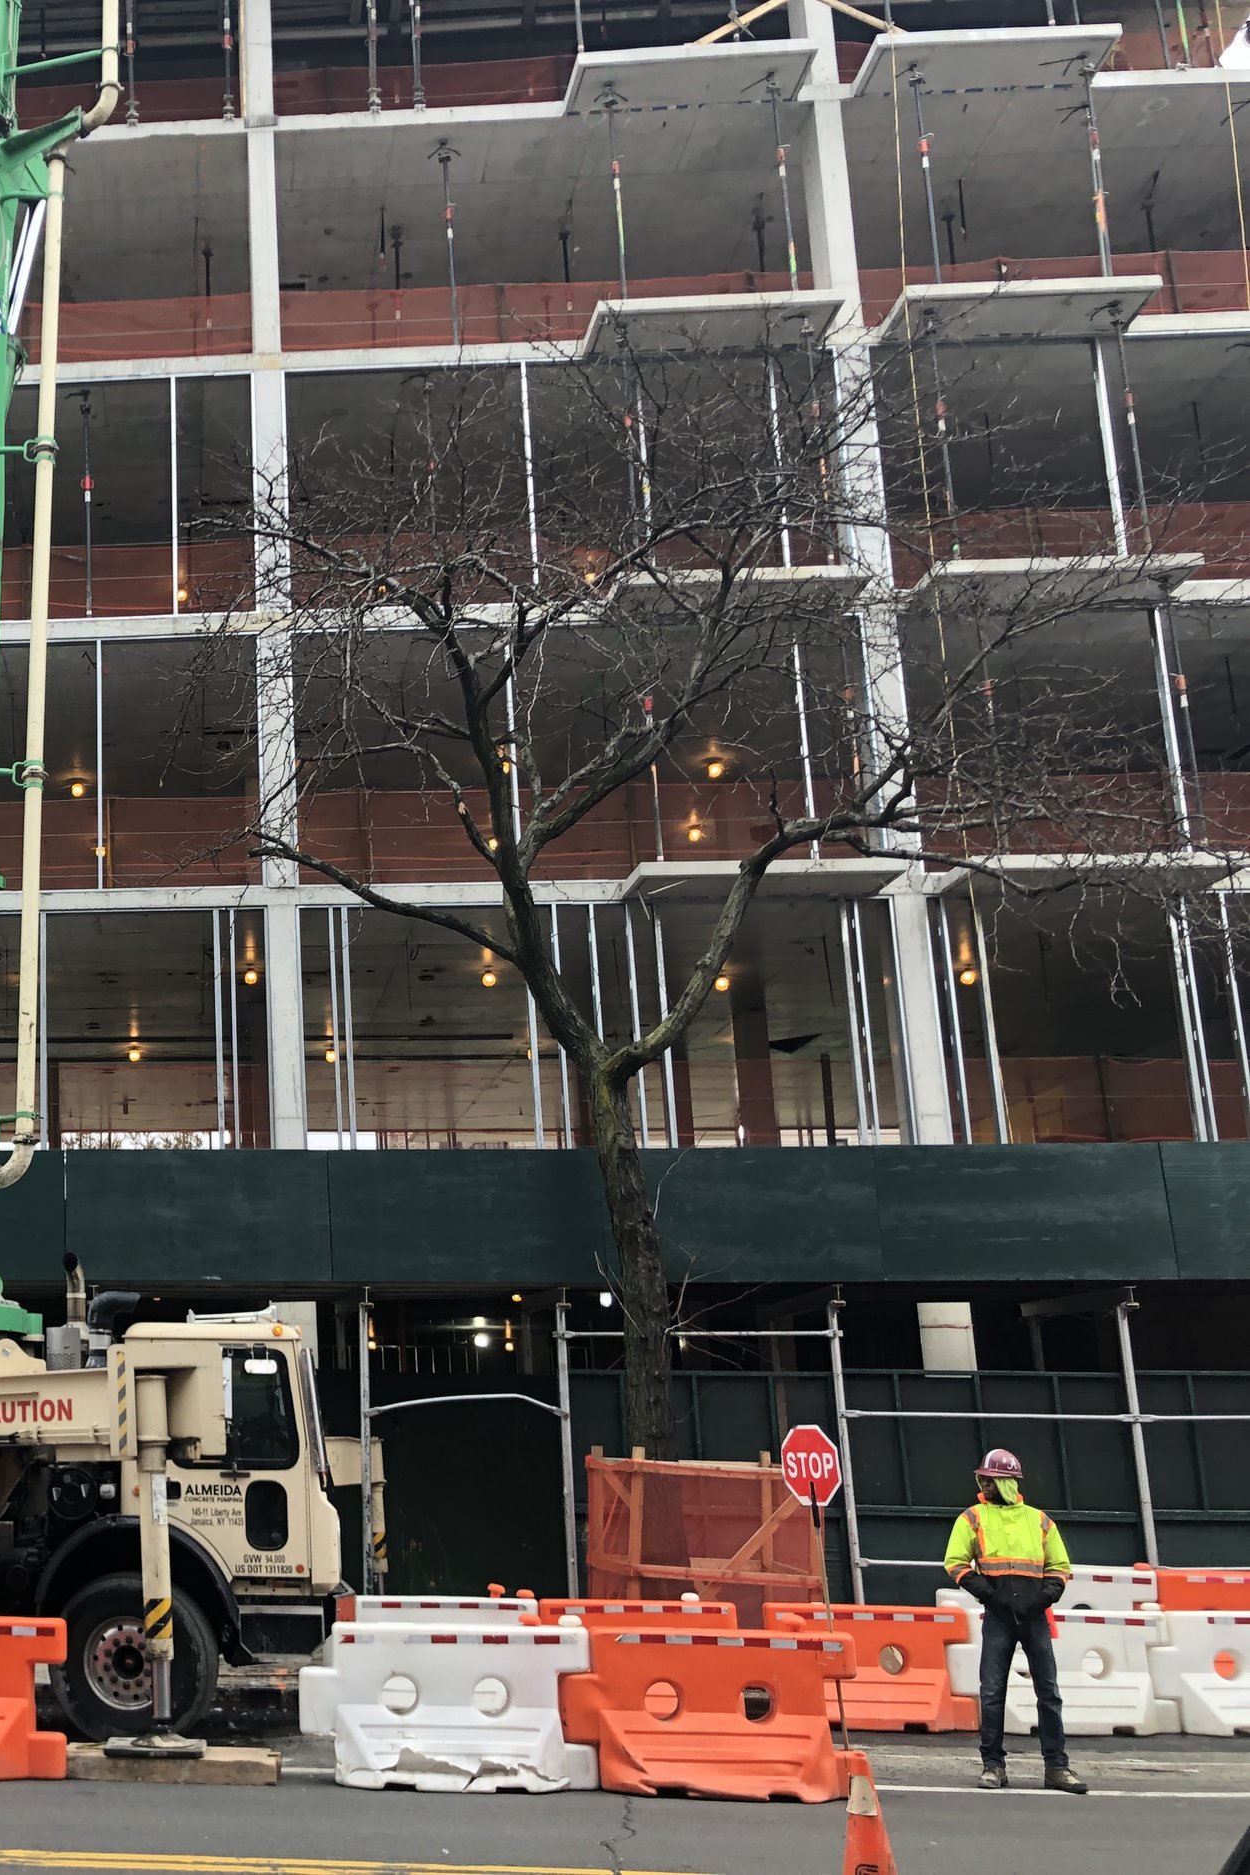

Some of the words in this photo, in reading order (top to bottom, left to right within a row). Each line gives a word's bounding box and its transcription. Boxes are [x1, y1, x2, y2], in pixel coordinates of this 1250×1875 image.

[786, 1451, 834, 1479] STOP
[185, 1484, 242, 1496] ALMEIDA
[211, 1507, 230, 1518] Liberty
[232, 1508, 242, 1517] Ave
[217, 1517, 225, 1526] NY
[243, 1554, 262, 1563] GVW
[235, 1564, 245, 1573] US
[247, 1564, 263, 1573] DOT
